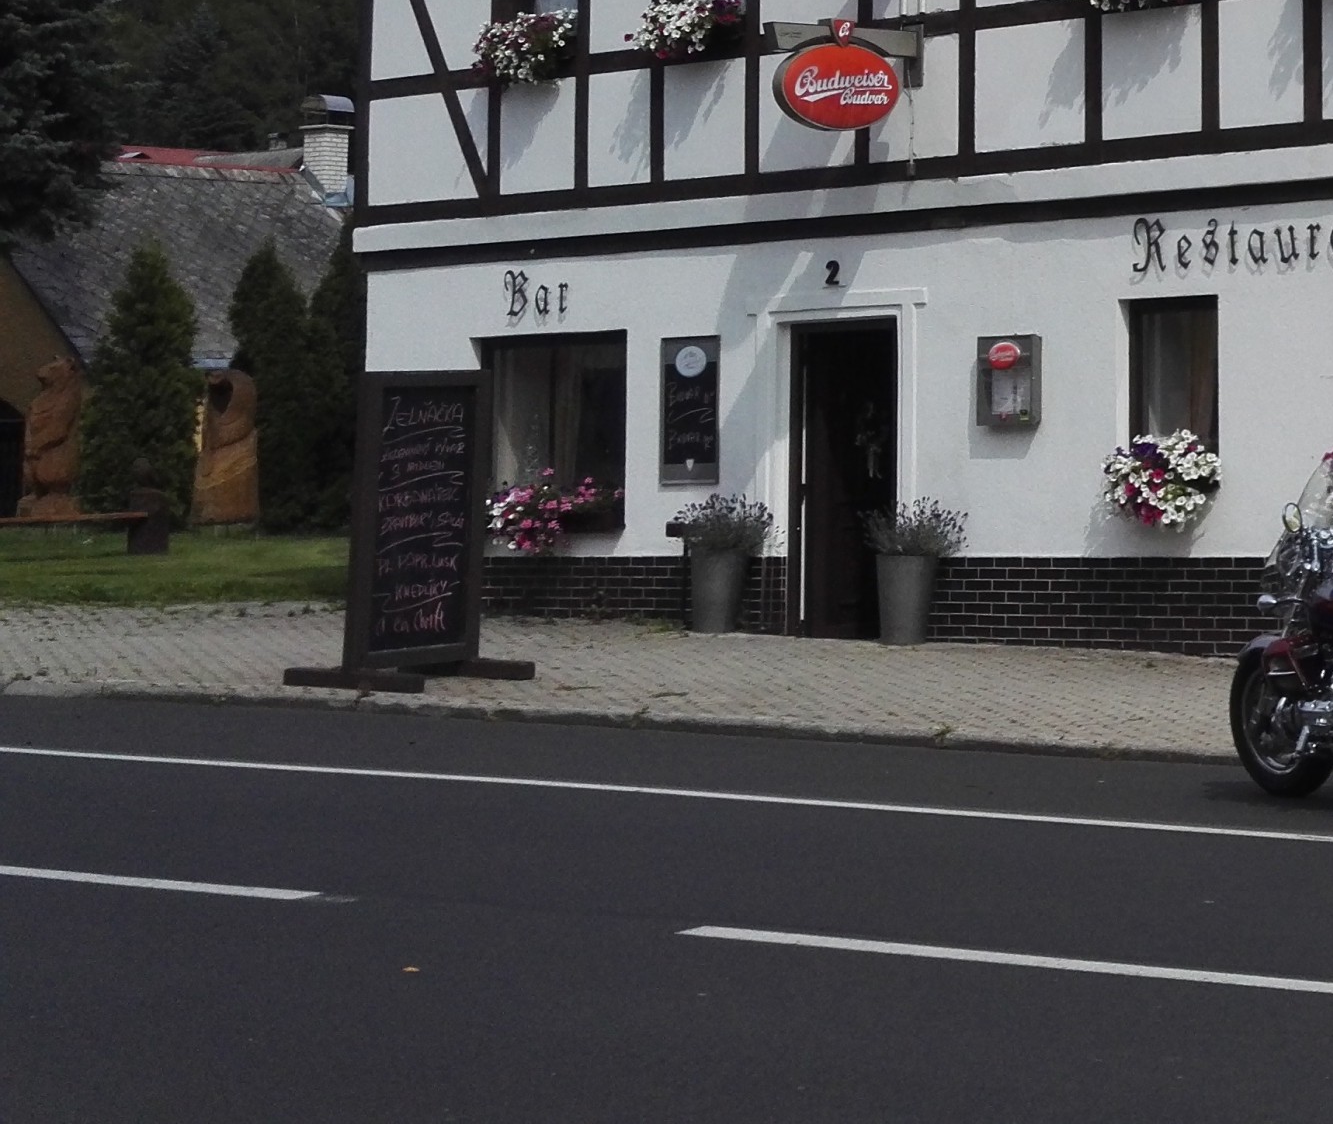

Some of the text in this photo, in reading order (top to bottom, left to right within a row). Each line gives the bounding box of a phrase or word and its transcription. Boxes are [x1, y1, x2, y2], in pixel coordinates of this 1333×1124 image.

[795, 66, 893, 101] Budweiser
[839, 87, 890, 106] Budvar
[824, 260, 841, 285] 2
[503, 269, 569, 317] Bar
